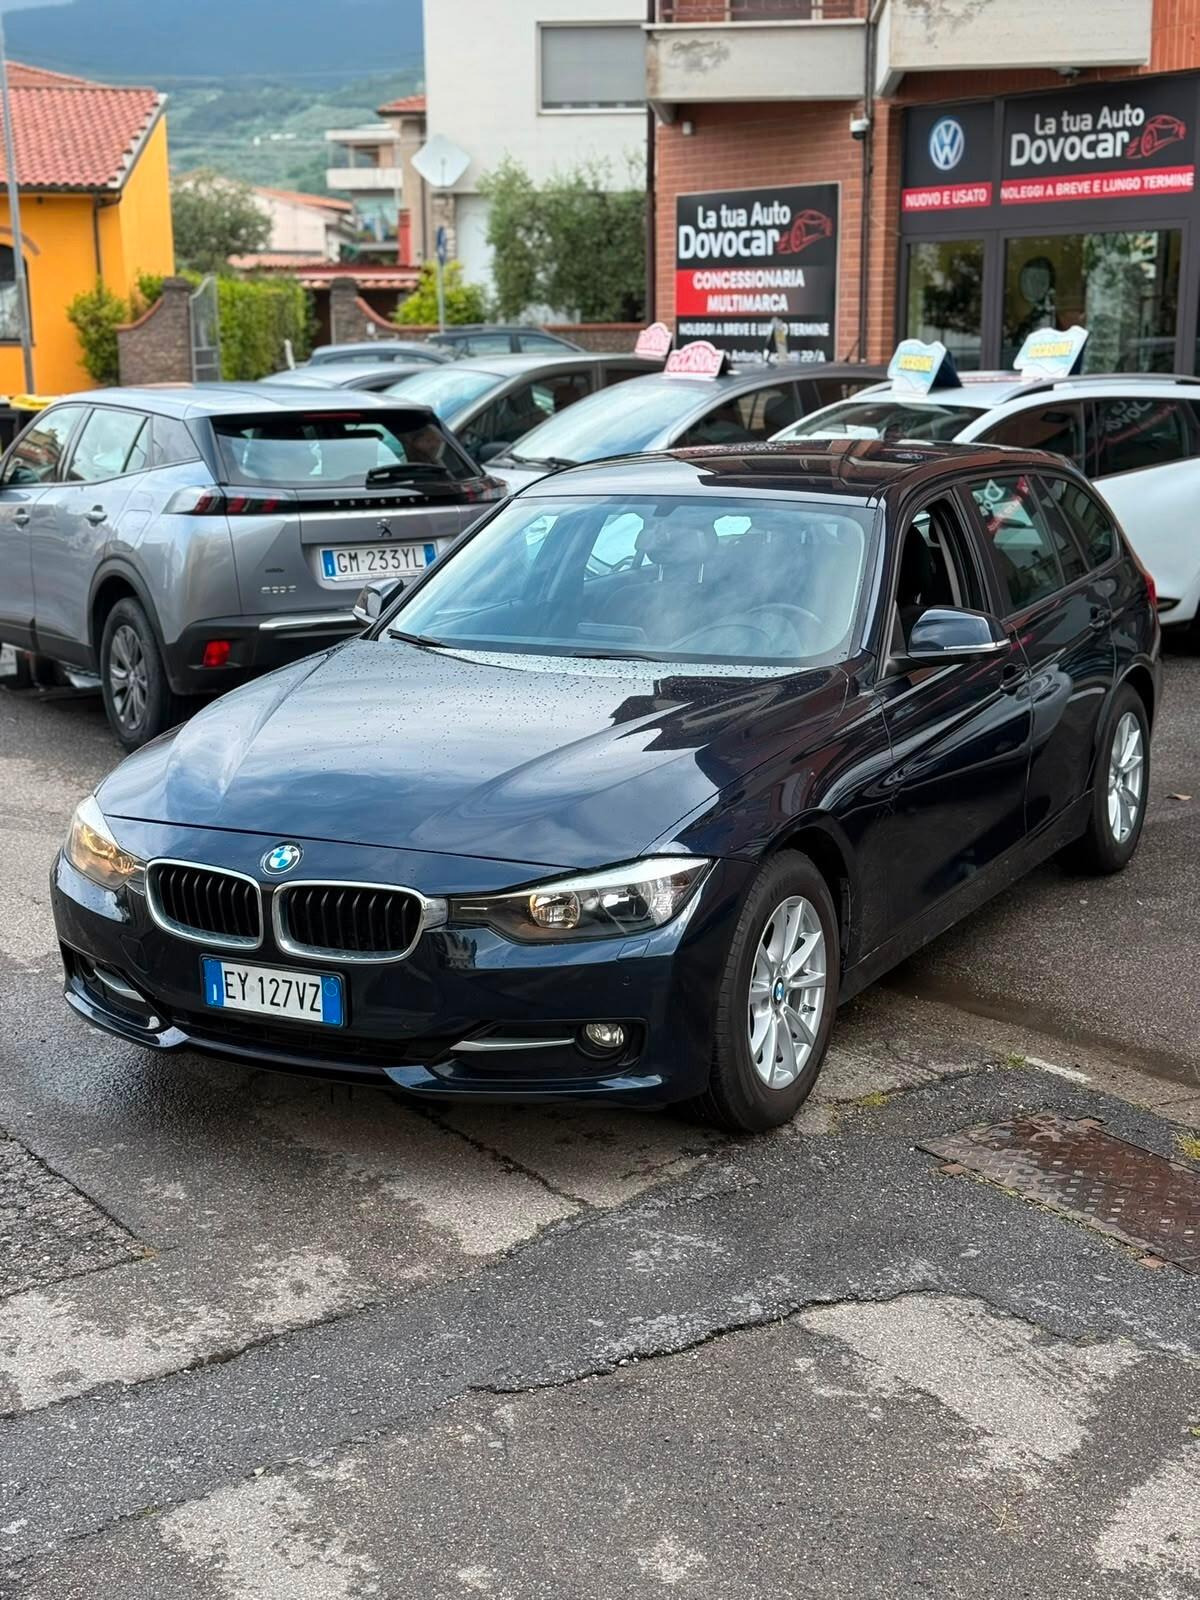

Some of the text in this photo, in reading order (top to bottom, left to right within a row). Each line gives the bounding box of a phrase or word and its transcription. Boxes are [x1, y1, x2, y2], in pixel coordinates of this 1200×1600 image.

[1034, 103, 1145, 137] La tua Auto
[1010, 130, 1130, 167] Dovocar
[905, 187, 988, 208] NUOVO E USATO
[1000, 172, 1194, 199] NOLEGGI A BREVE E LUNGO TERMINE
[697, 200, 791, 229] La tua Auto
[678, 225, 780, 259] Dovocar
[692, 269, 805, 290] CONCESSIONARIA
[706, 294, 789, 313] MULTIMARCA
[750, 322, 757, 336] E
[789, 322, 830, 337] TERMINE
[337, 547, 424, 574] GM 233YL
[223, 970, 322, 1013] EY 127VZ
